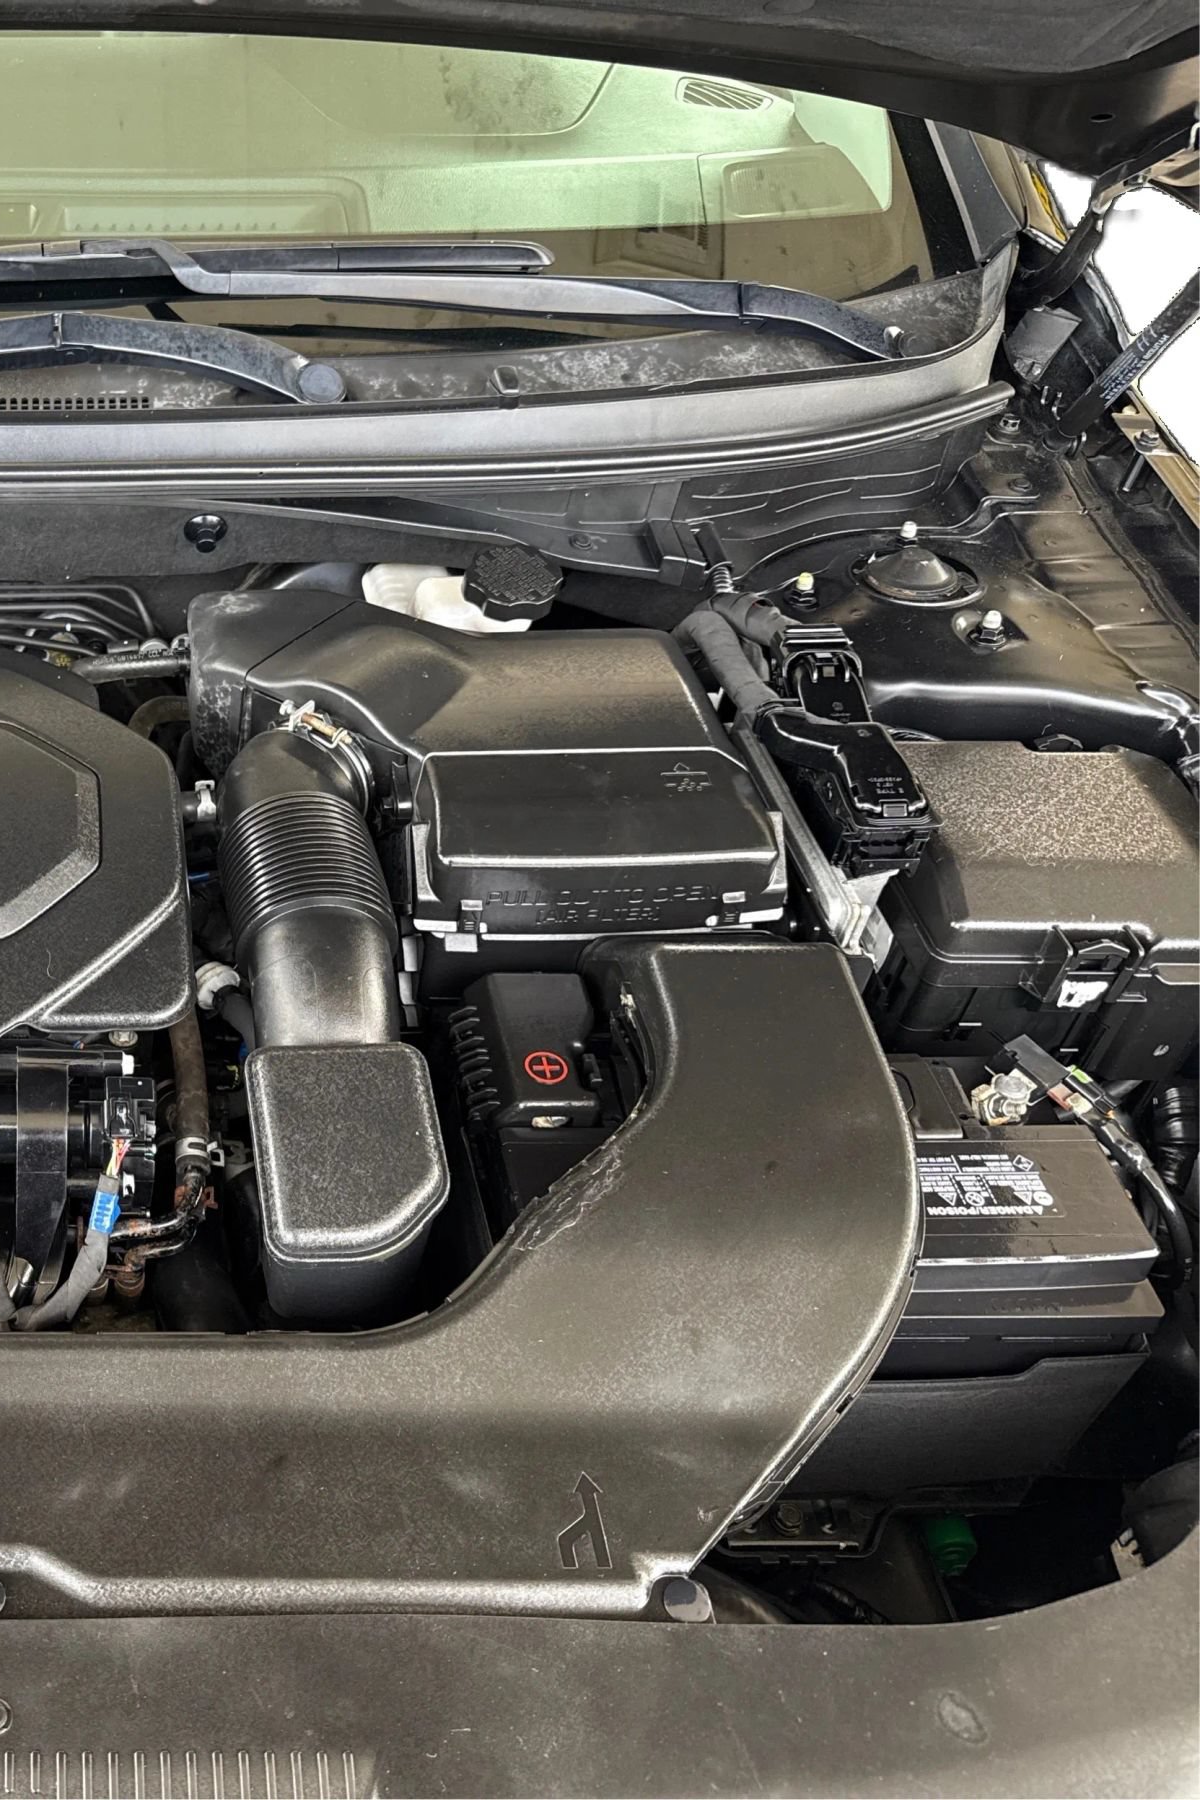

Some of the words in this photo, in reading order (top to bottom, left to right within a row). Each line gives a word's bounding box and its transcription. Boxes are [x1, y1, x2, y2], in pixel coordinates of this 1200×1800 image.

[486, 890, 547, 906] PULL
[556, 889, 609, 905] OUT
[613, 888, 644, 903] TO
[652, 885, 720, 902] OPEN
